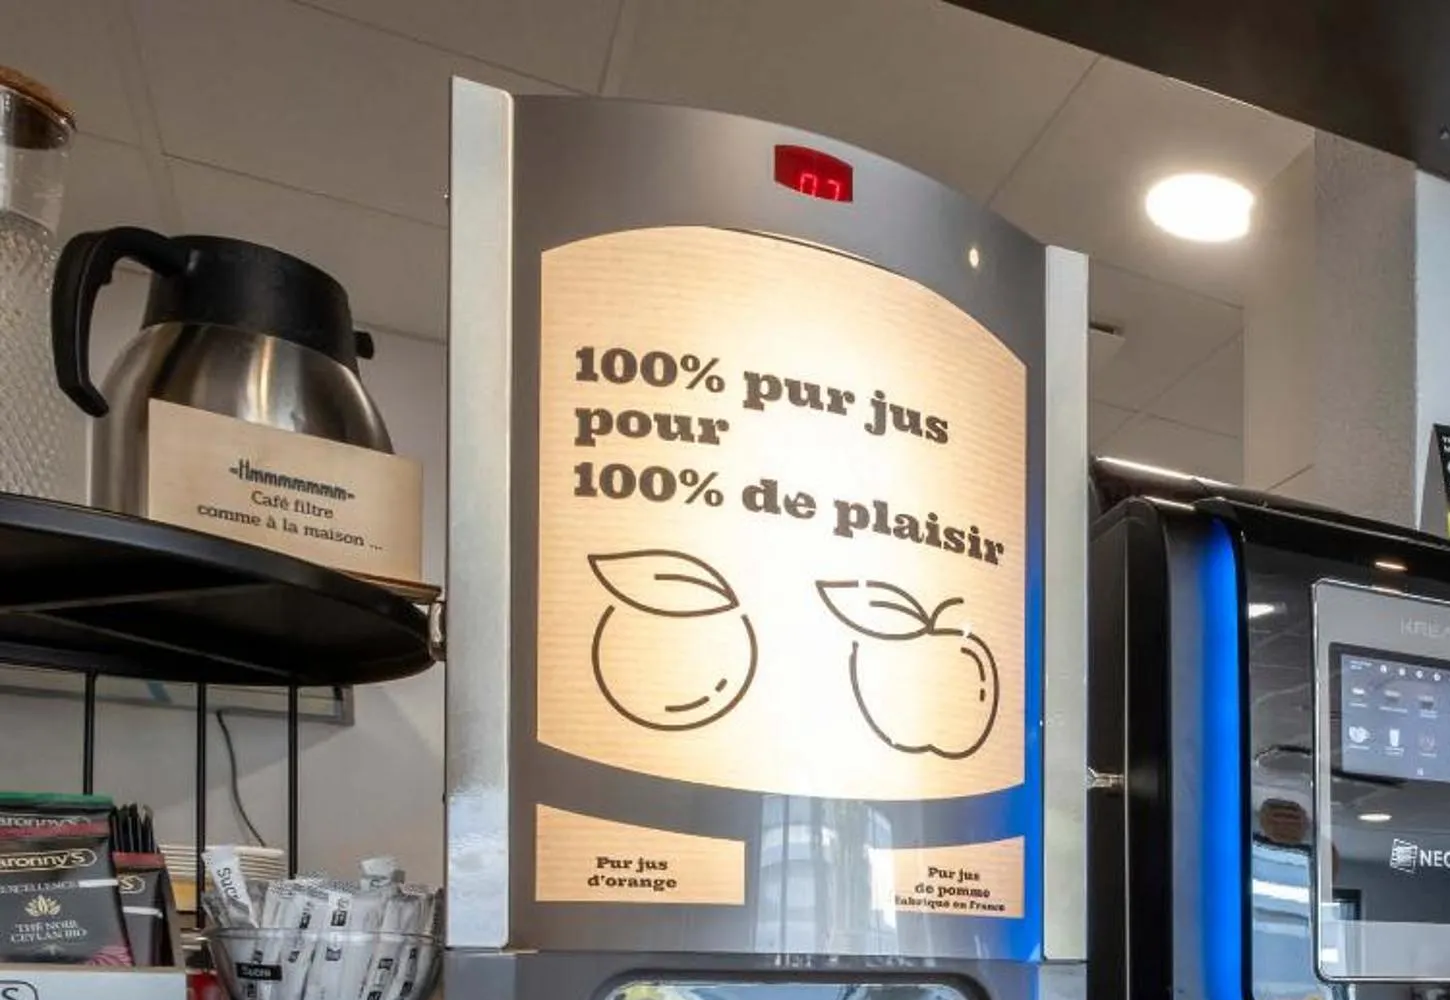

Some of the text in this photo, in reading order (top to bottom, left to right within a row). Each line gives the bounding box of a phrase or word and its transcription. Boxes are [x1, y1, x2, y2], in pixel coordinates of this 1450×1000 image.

[575, 346, 949, 445] 100% pur jus
[574, 407, 729, 447] pour
[251, 490, 334, 519] Café filtre
[573, 462, 1004, 566] 100% de plaisir
[197, 505, 261, 526] comme
[266, 515, 277, 529] à
[283, 518, 298, 534] la
[304, 525, 364, 547] maison
[596, 856, 668, 873] Pur jus
[928, 866, 980, 883] Pur jus
[587, 875, 677, 892] d'orange
[915, 883, 990, 898] de pomme
[953, 901, 967, 909] en
[969, 900, 1005, 911] France
